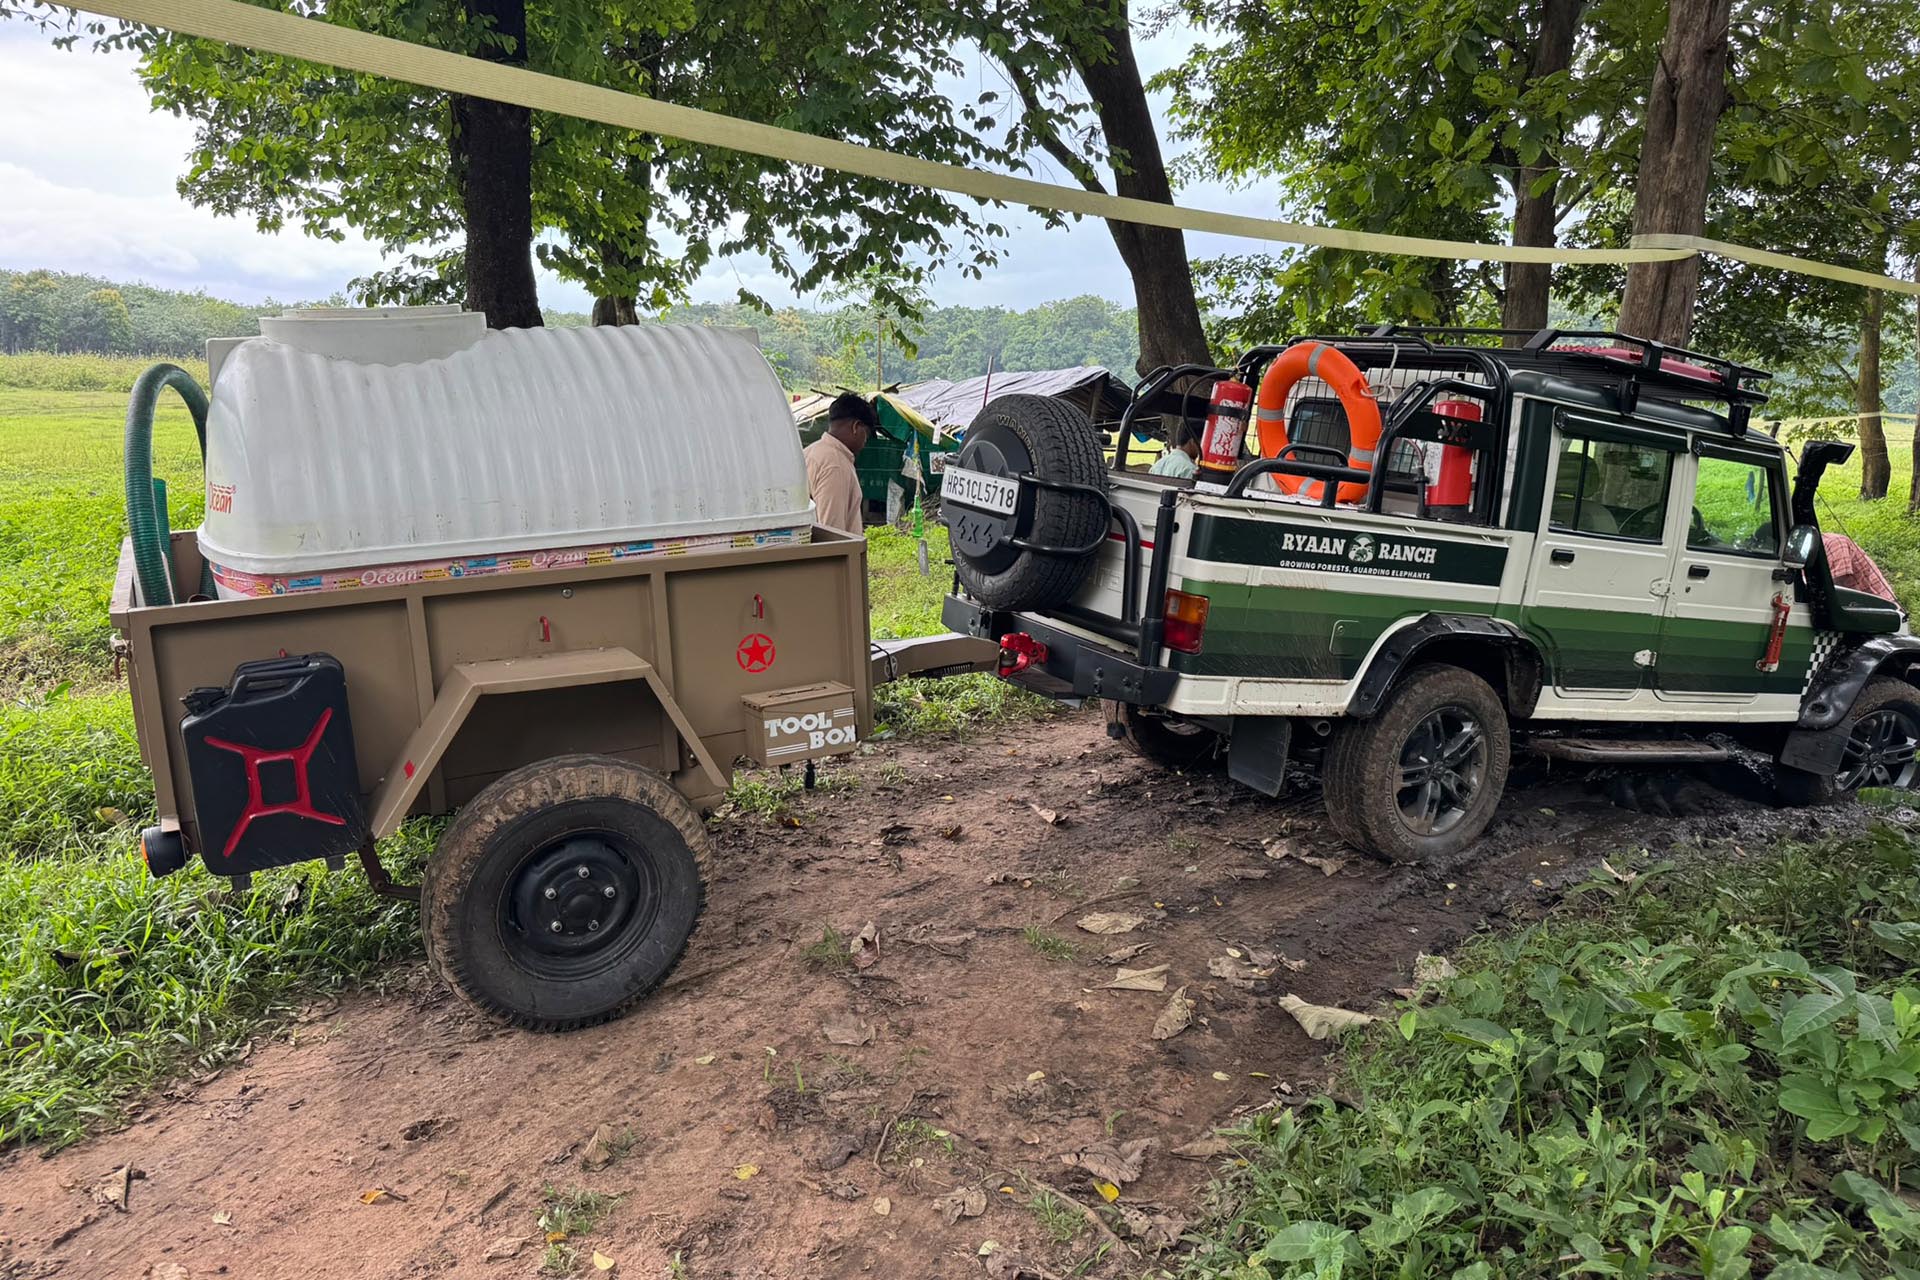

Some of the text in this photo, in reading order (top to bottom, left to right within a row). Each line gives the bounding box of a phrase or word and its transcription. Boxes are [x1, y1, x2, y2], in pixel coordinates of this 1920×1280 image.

[208, 481, 233, 514] Ocean
[946, 475, 1015, 508] HR51CL5718
[1281, 533, 1437, 564] RYAAN RANCH
[361, 569, 418, 585] Ocean
[1279, 560, 1431, 580] GROWING FORESTS, GUARDING ELEPHANTS
[764, 712, 832, 737] TOOL
[808, 725, 856, 750] BOX
